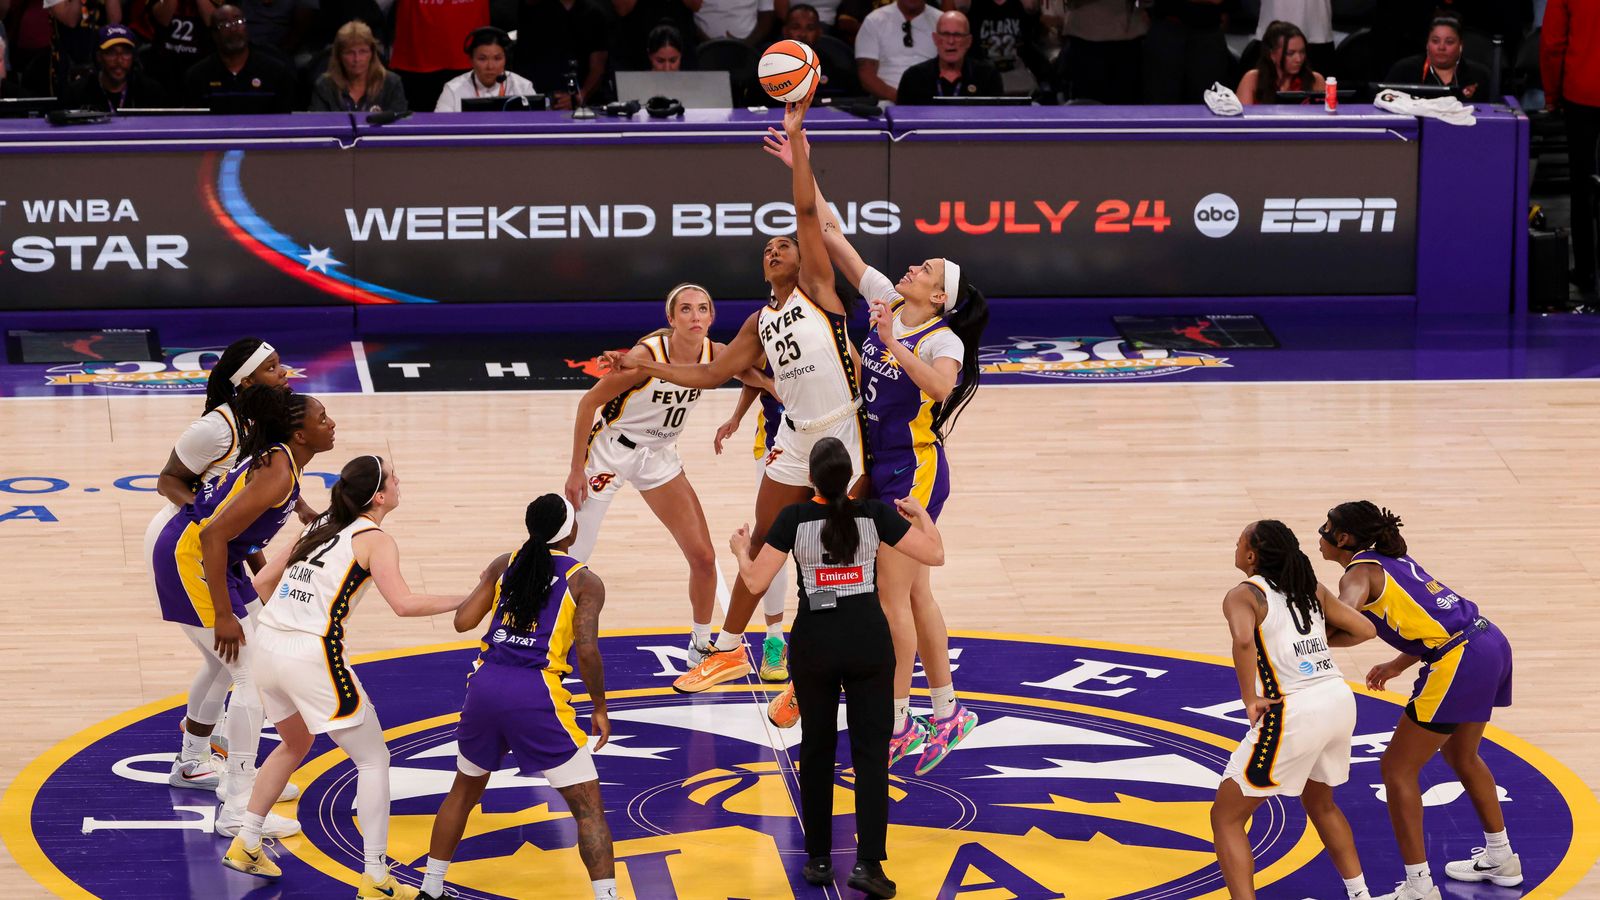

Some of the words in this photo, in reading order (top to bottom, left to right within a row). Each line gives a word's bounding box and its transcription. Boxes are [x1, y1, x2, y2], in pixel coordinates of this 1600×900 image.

[171, 19, 194, 41] 22
[981, 18, 1020, 38] CLARK
[22, 198, 139, 223] WNBA
[345, 204, 656, 241] WEEKEND
[672, 201, 900, 237] BEGNS
[914, 200, 1080, 235] JULY
[1095, 199, 1171, 232] 24
[1196, 206, 1237, 222] abc
[1260, 198, 1398, 233] ESPN
[11, 235, 189, 272] STAR
[761, 305, 806, 346] FEVER
[775, 332, 801, 367] 25
[778, 363, 816, 382] salesforce
[1022, 357, 1178, 371] SEASONS
[93, 371, 209, 382] SEASO
[865, 376, 879, 403] 5
[663, 406, 686, 428] 10
[289, 565, 314, 583] CLARK
[820, 571, 859, 582] Emirates
[289, 589, 314, 603] AT&T
[506, 635, 536, 647] AT&T
[1293, 637, 1327, 656] MITCHELL
